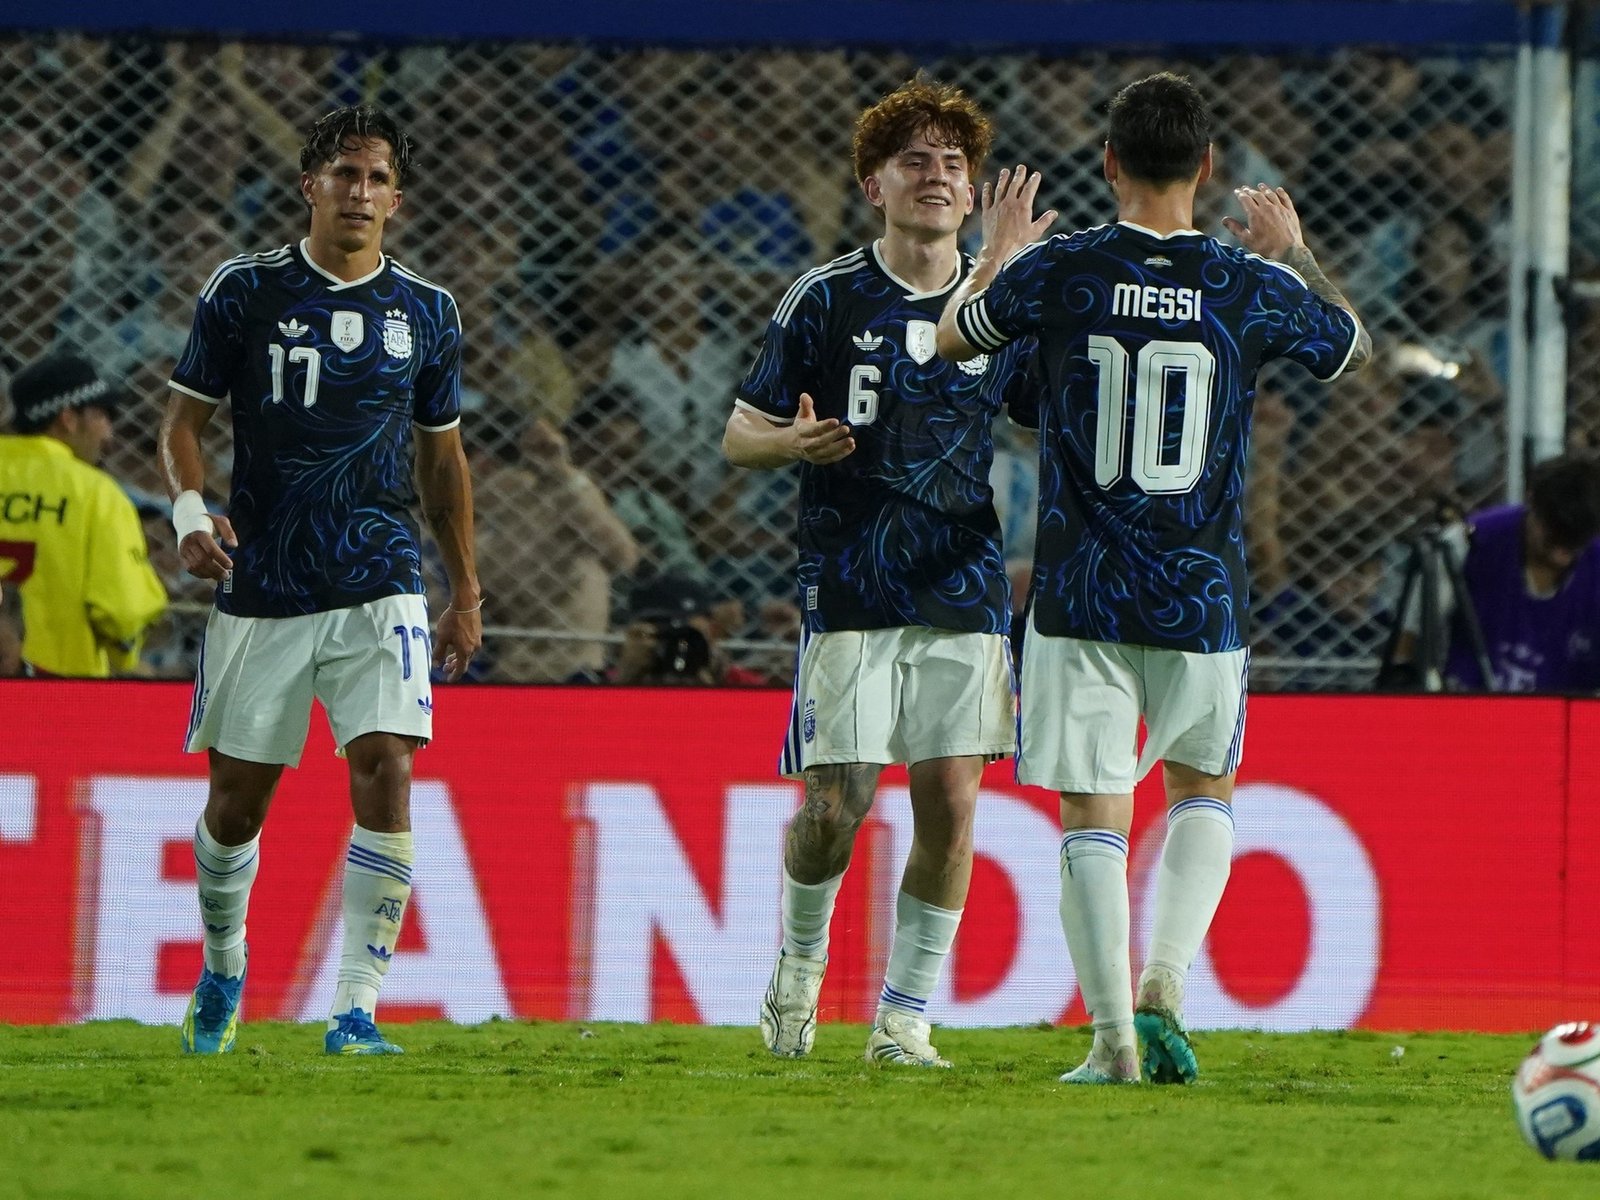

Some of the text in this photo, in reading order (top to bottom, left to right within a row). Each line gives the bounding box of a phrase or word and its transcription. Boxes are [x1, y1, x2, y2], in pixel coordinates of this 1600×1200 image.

[1112, 282, 1202, 322] MESSI
[268, 343, 322, 408] 17
[847, 364, 882, 426] 6
[1088, 334, 1216, 495] 10
[0, 491, 68, 526] CH
[393, 624, 433, 683] 17
